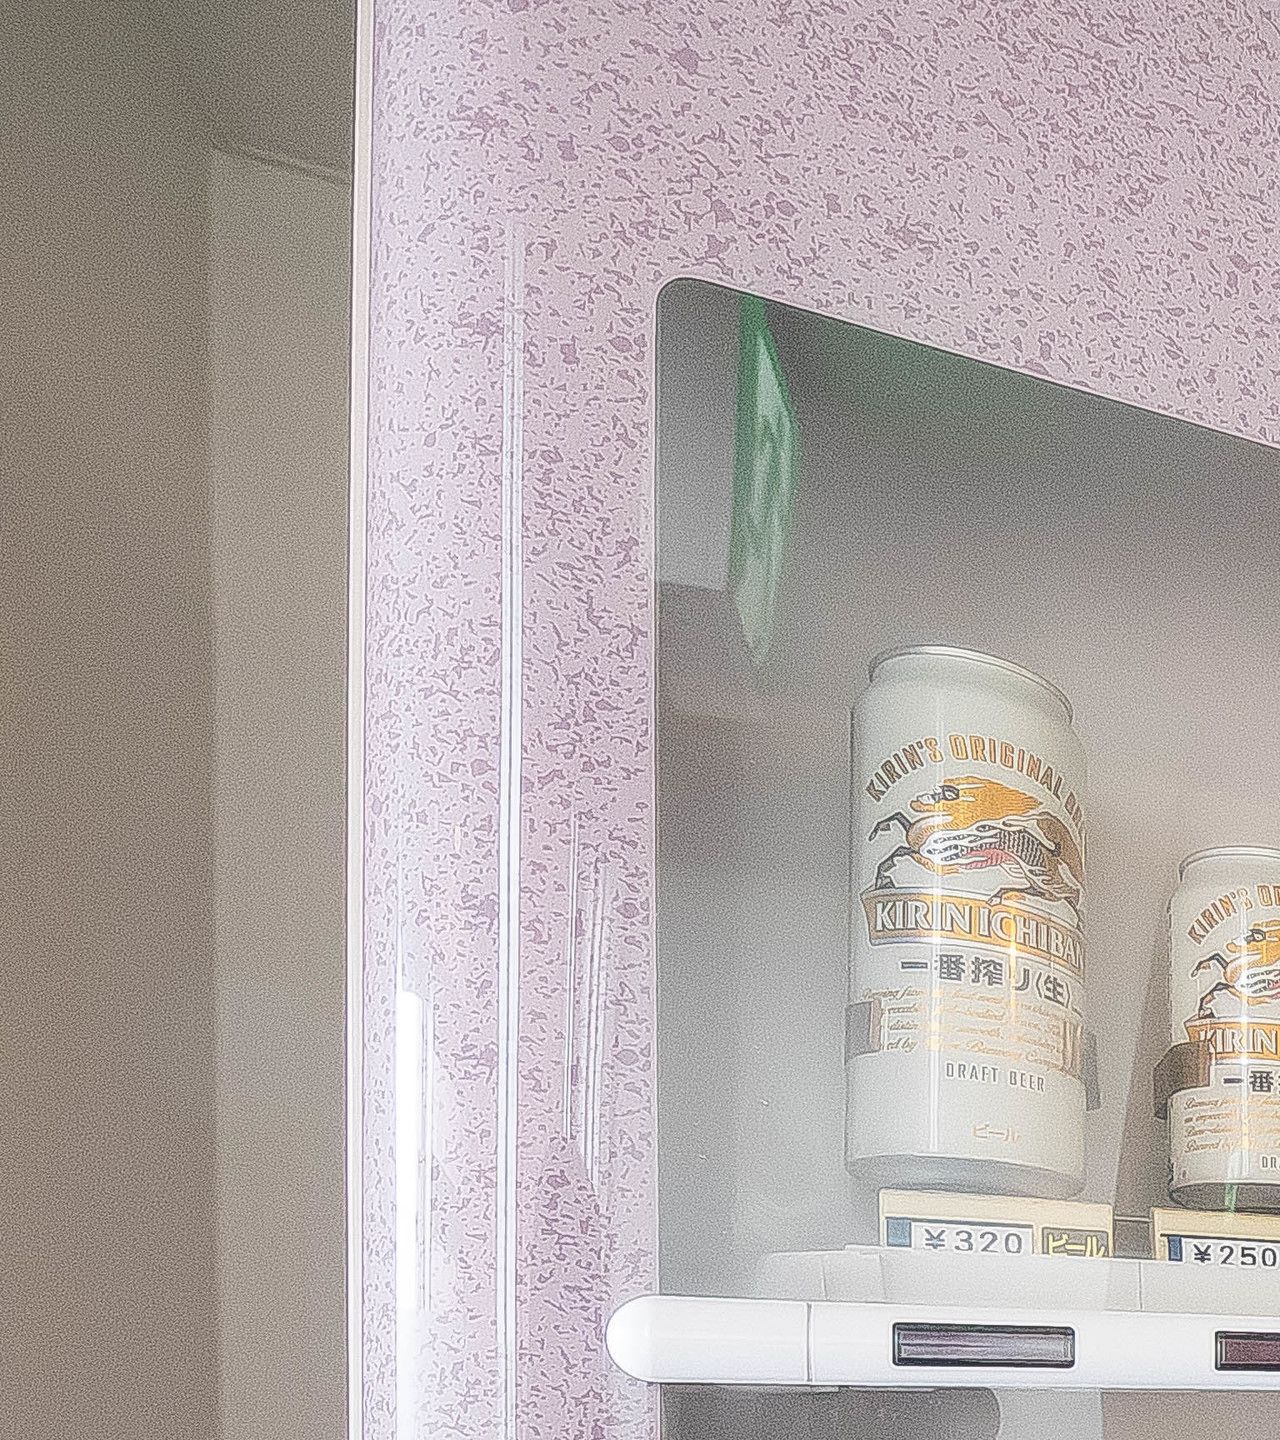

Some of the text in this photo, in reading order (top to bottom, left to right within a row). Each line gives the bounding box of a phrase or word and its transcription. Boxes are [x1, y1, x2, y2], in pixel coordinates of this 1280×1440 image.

[949, 735, 1060, 800] ORIGINAL
[876, 900, 972, 940] KIRIN
[946, 1061, 1046, 1093] DRAFT BEER
[924, 1229, 1023, 1255] ¥320
[1193, 1244, 1277, 1269] ¥250
